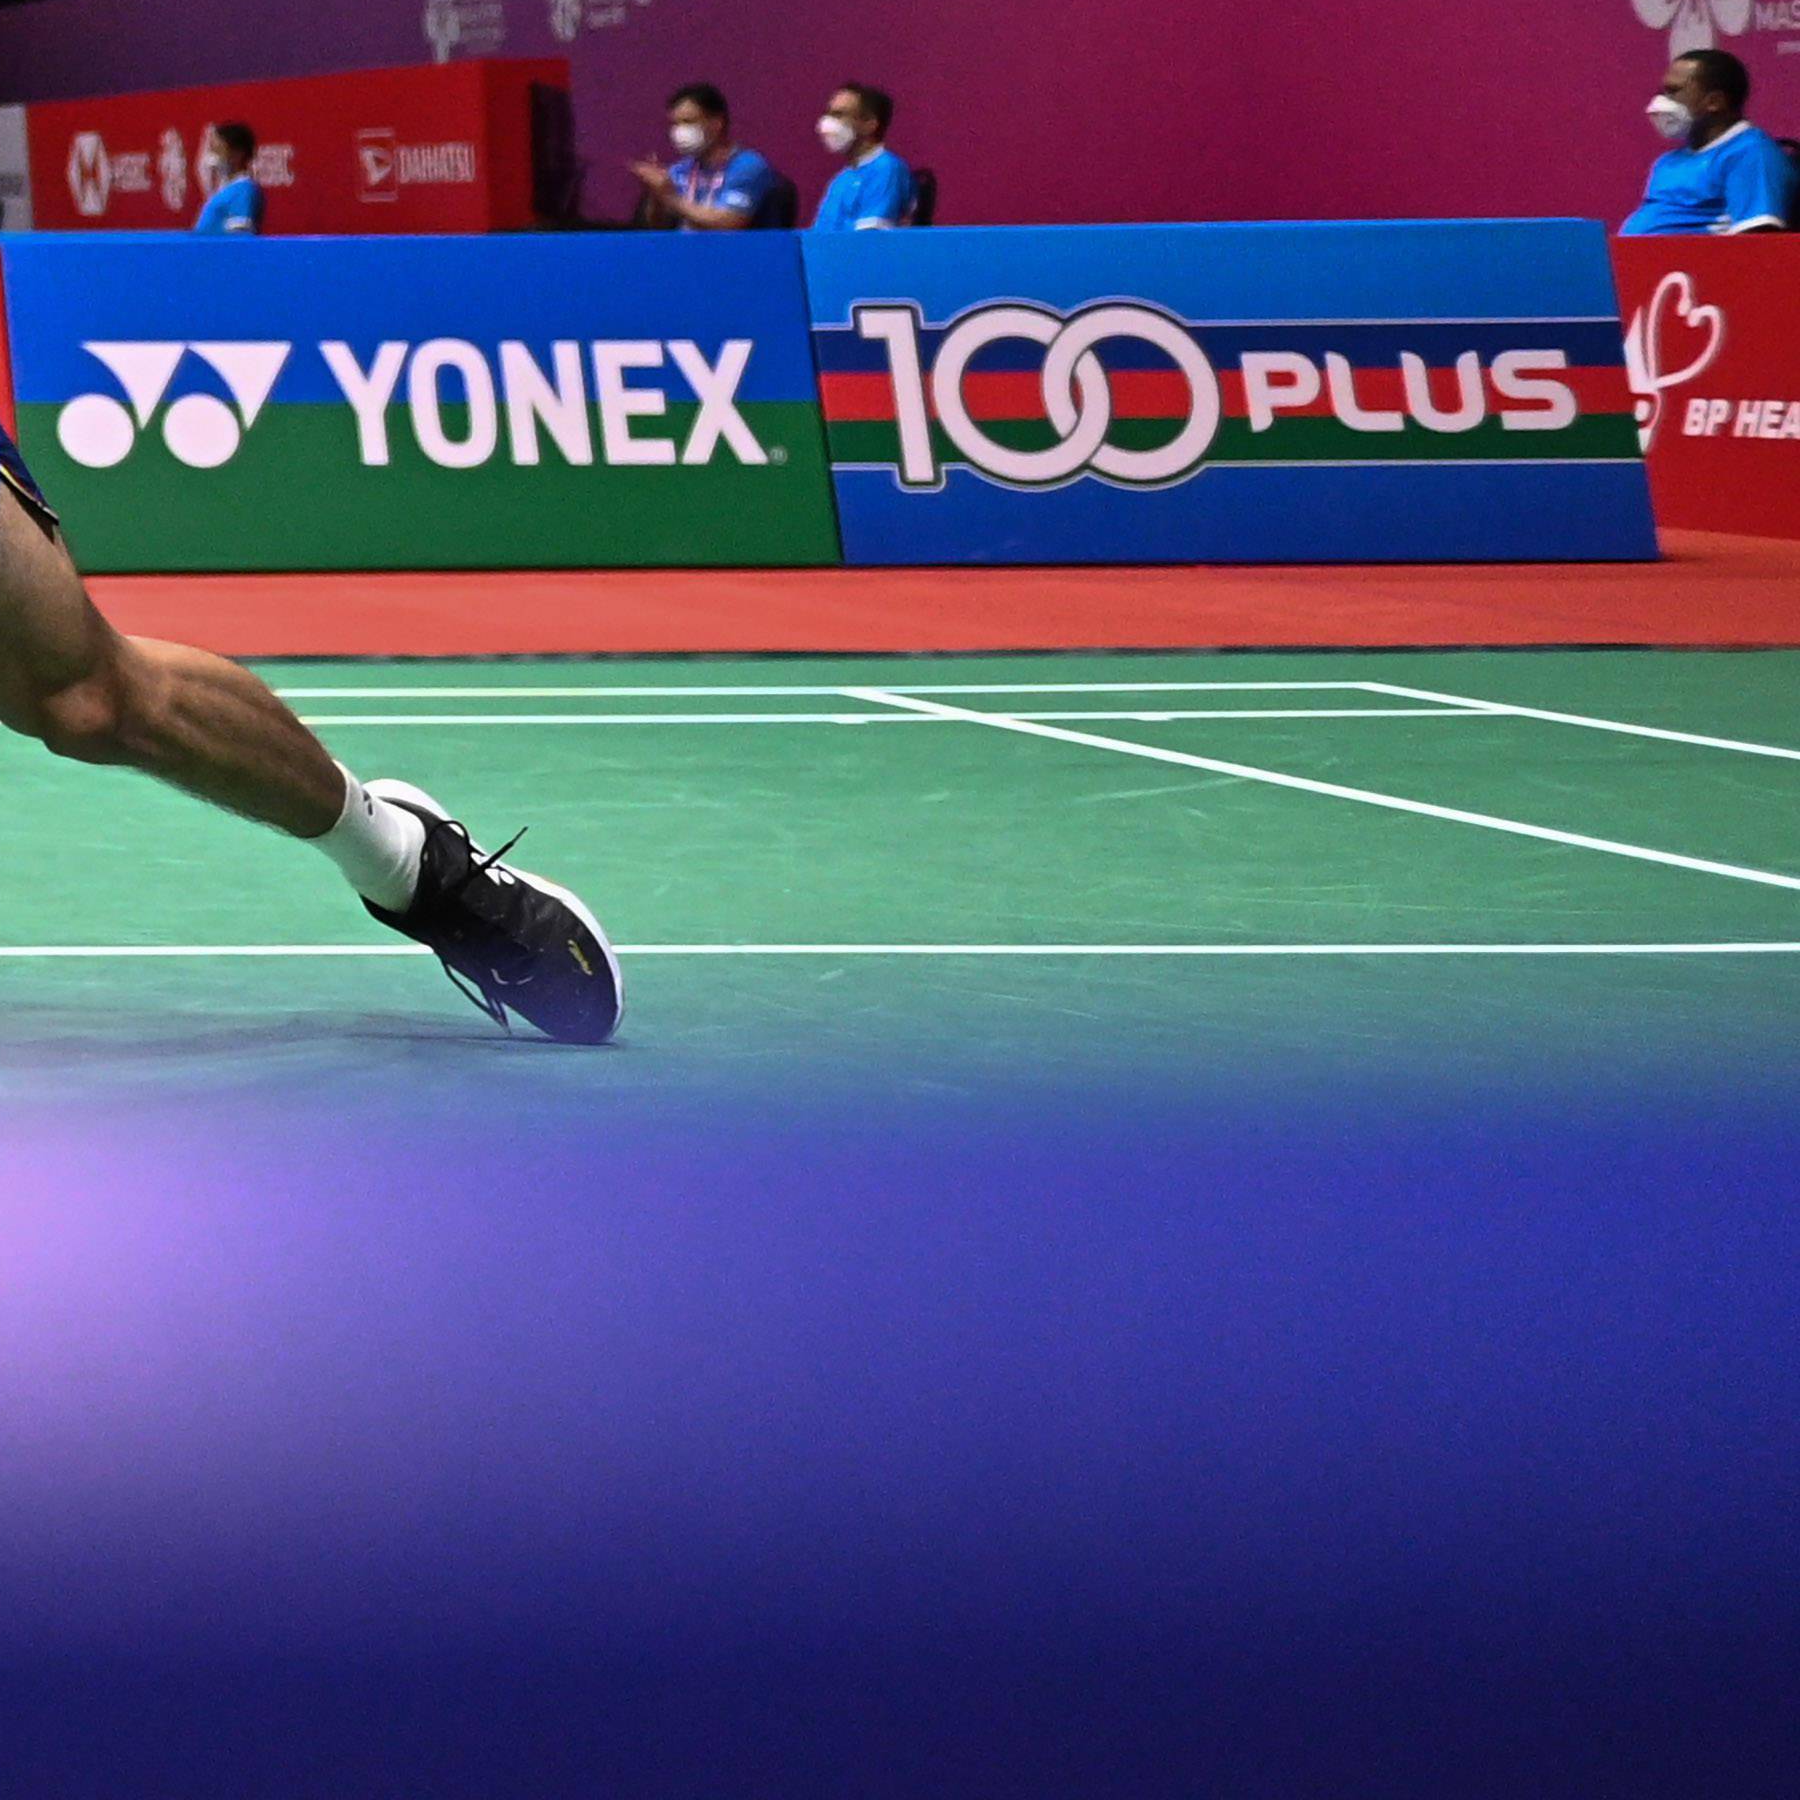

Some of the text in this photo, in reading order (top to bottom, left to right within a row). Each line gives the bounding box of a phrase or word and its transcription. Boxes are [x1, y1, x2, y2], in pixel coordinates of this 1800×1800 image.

[399, 141, 475, 184] DAIHATSU
[318, 337, 769, 469] YONEX
[855, 304, 1579, 485] 100 PLUS
[1683, 398, 1730, 437] BP
